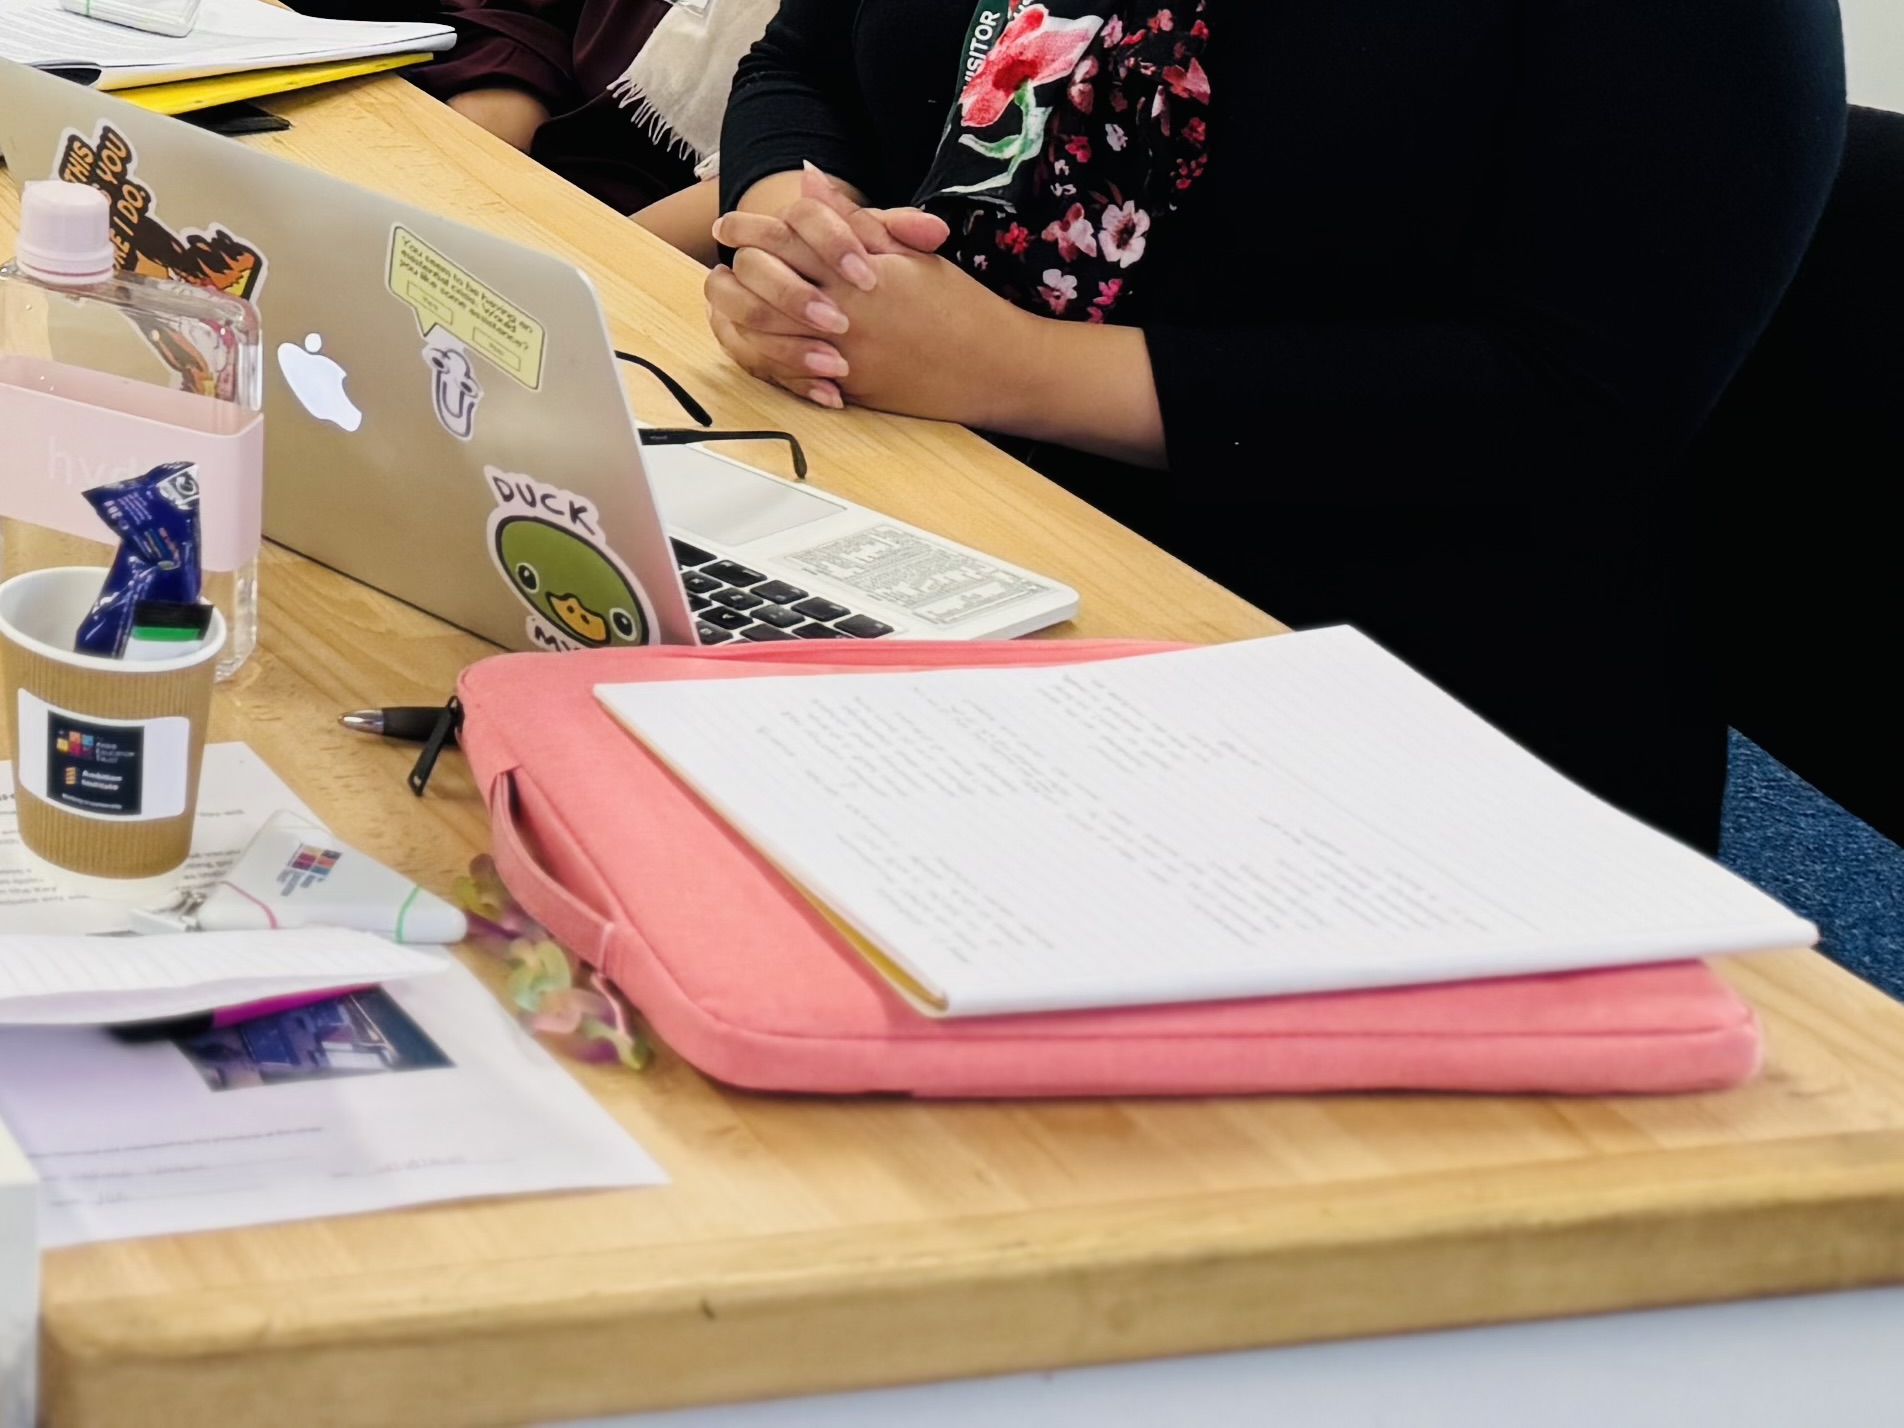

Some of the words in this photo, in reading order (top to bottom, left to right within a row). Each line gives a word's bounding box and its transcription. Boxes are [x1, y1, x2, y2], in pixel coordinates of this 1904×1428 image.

[64, 140, 94, 183] THIS
[96, 132, 128, 185] YOU
[492, 476, 596, 536] DUCK
